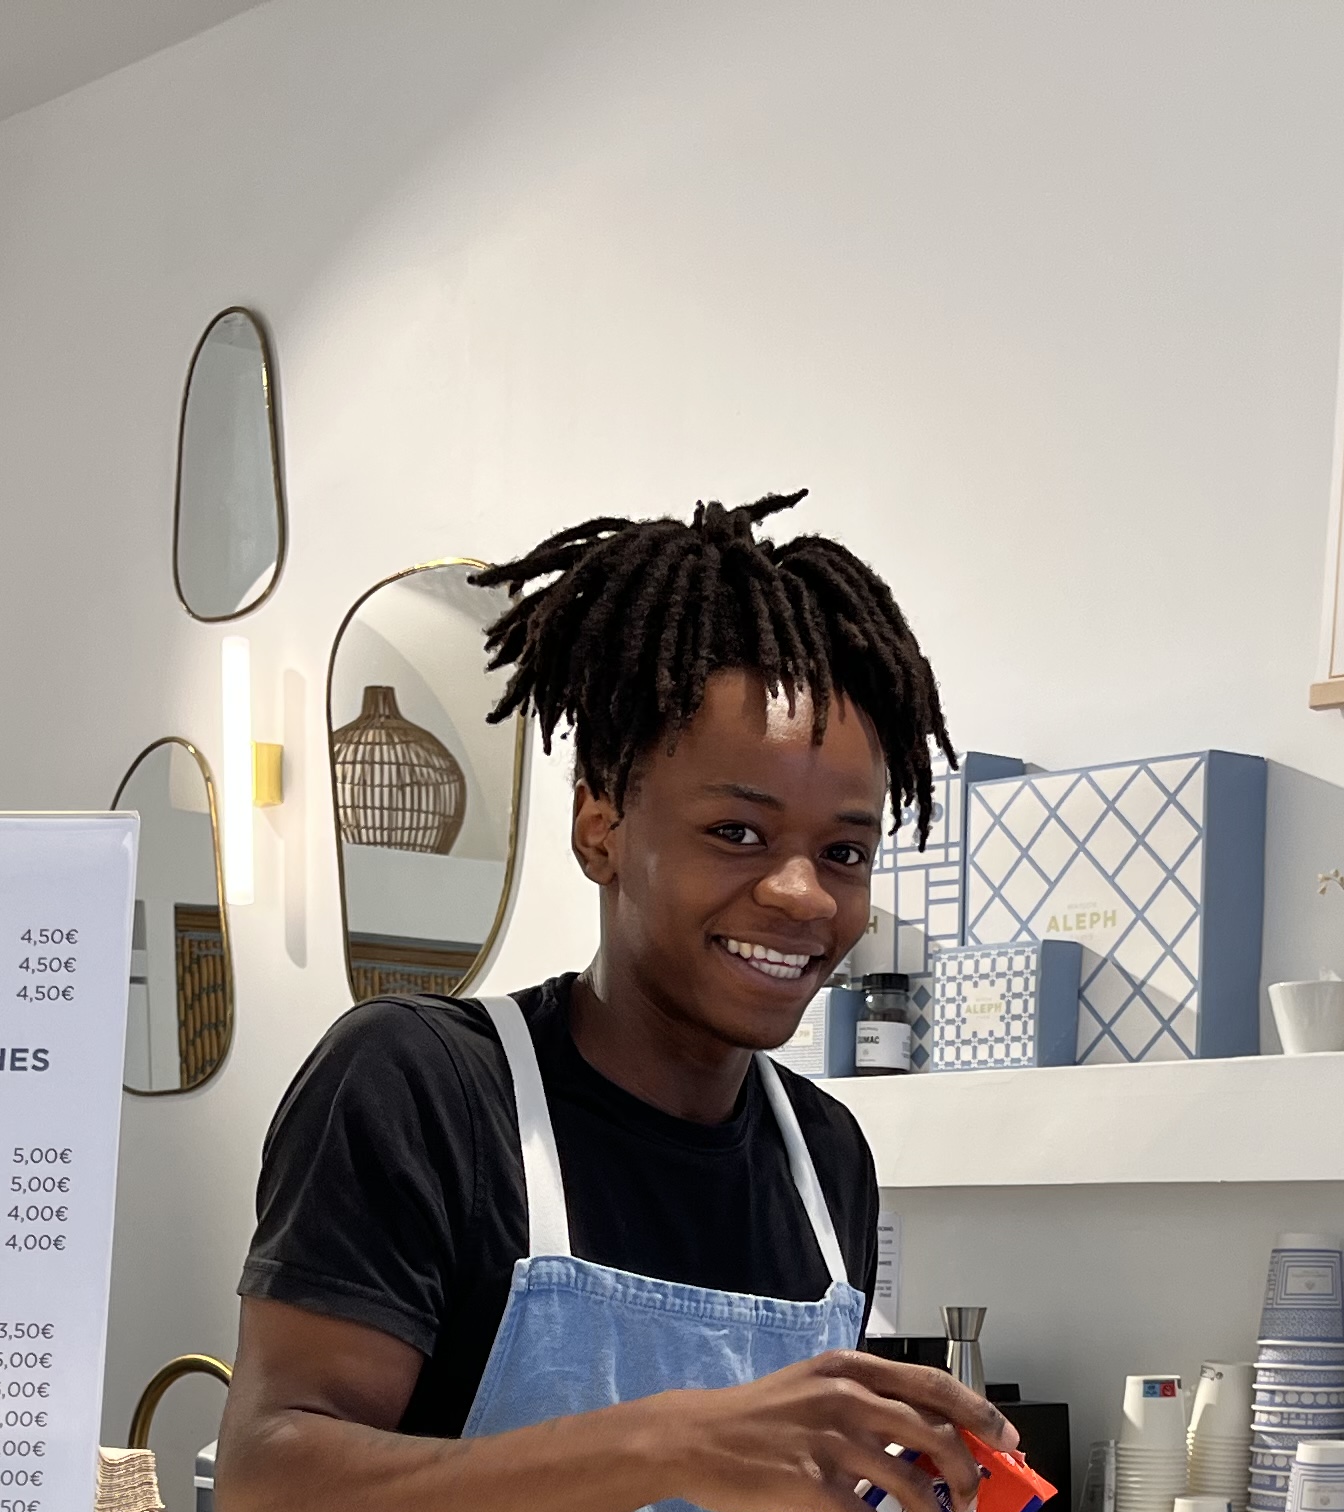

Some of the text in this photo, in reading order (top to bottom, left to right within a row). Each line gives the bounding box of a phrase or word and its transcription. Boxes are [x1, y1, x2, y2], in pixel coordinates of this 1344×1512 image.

[1046, 910, 1117, 934] ALEPH
[20, 928, 79, 947] 4,50€
[18, 956, 77, 975] 4,50€
[15, 984, 75, 1003] 4,50€
[965, 1002, 1002, 1014] ALEPH
[12, 1147, 73, 1166] 5,00€
[10, 1175, 71, 1195] 5,00€
[6, 1204, 69, 1223] 4,00€
